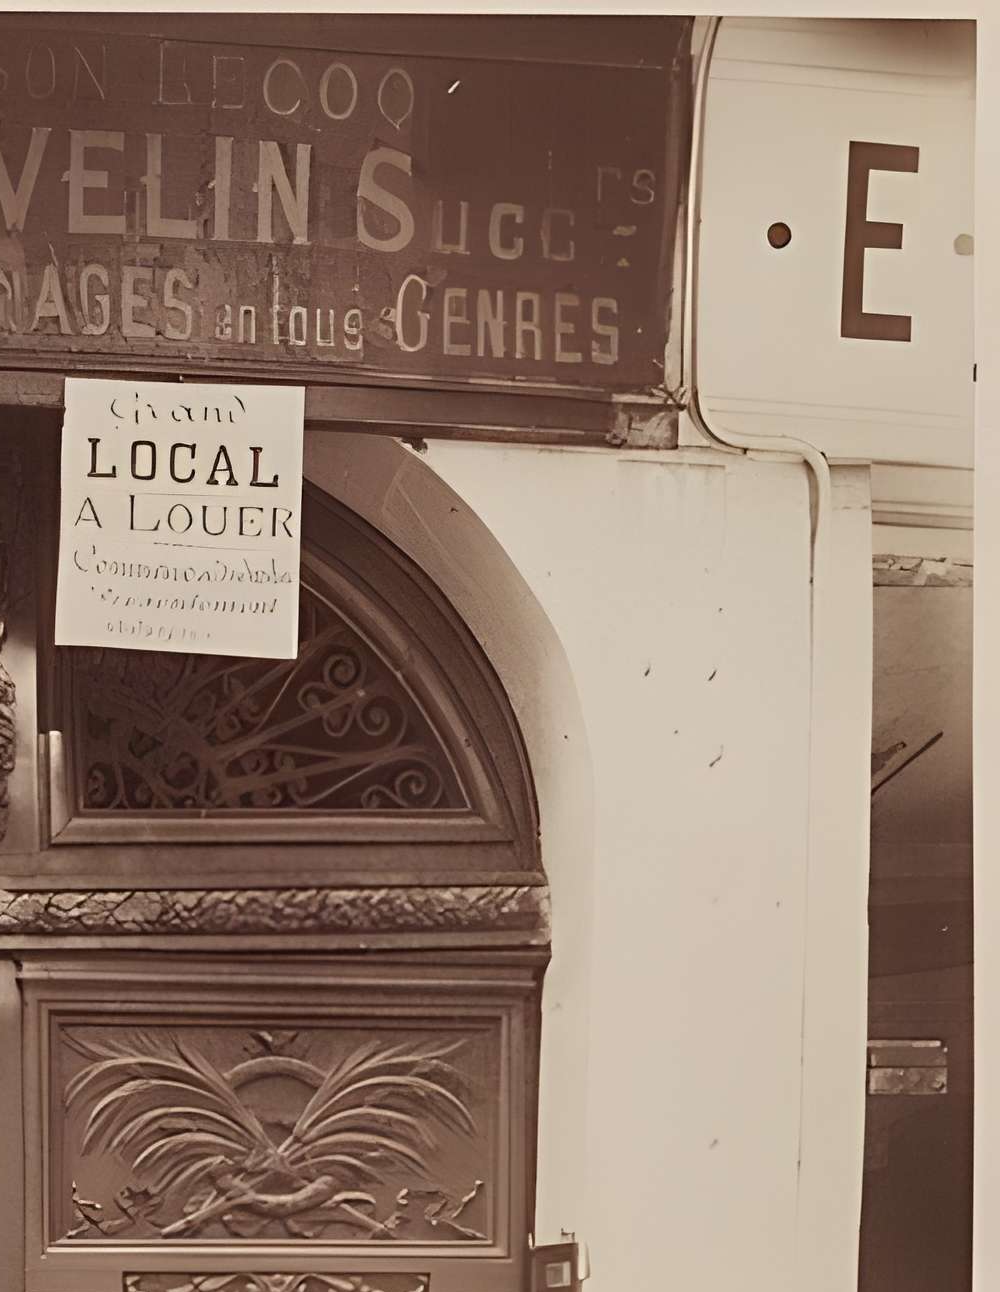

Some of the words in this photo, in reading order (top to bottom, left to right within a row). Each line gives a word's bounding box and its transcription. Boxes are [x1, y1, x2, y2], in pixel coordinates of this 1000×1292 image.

[840, 140, 920, 342] E
[396, 273, 619, 366] GENRES
[86, 437, 279, 488] LOCAL
[74, 497, 103, 529] A
[129, 495, 294, 538] LOUER
